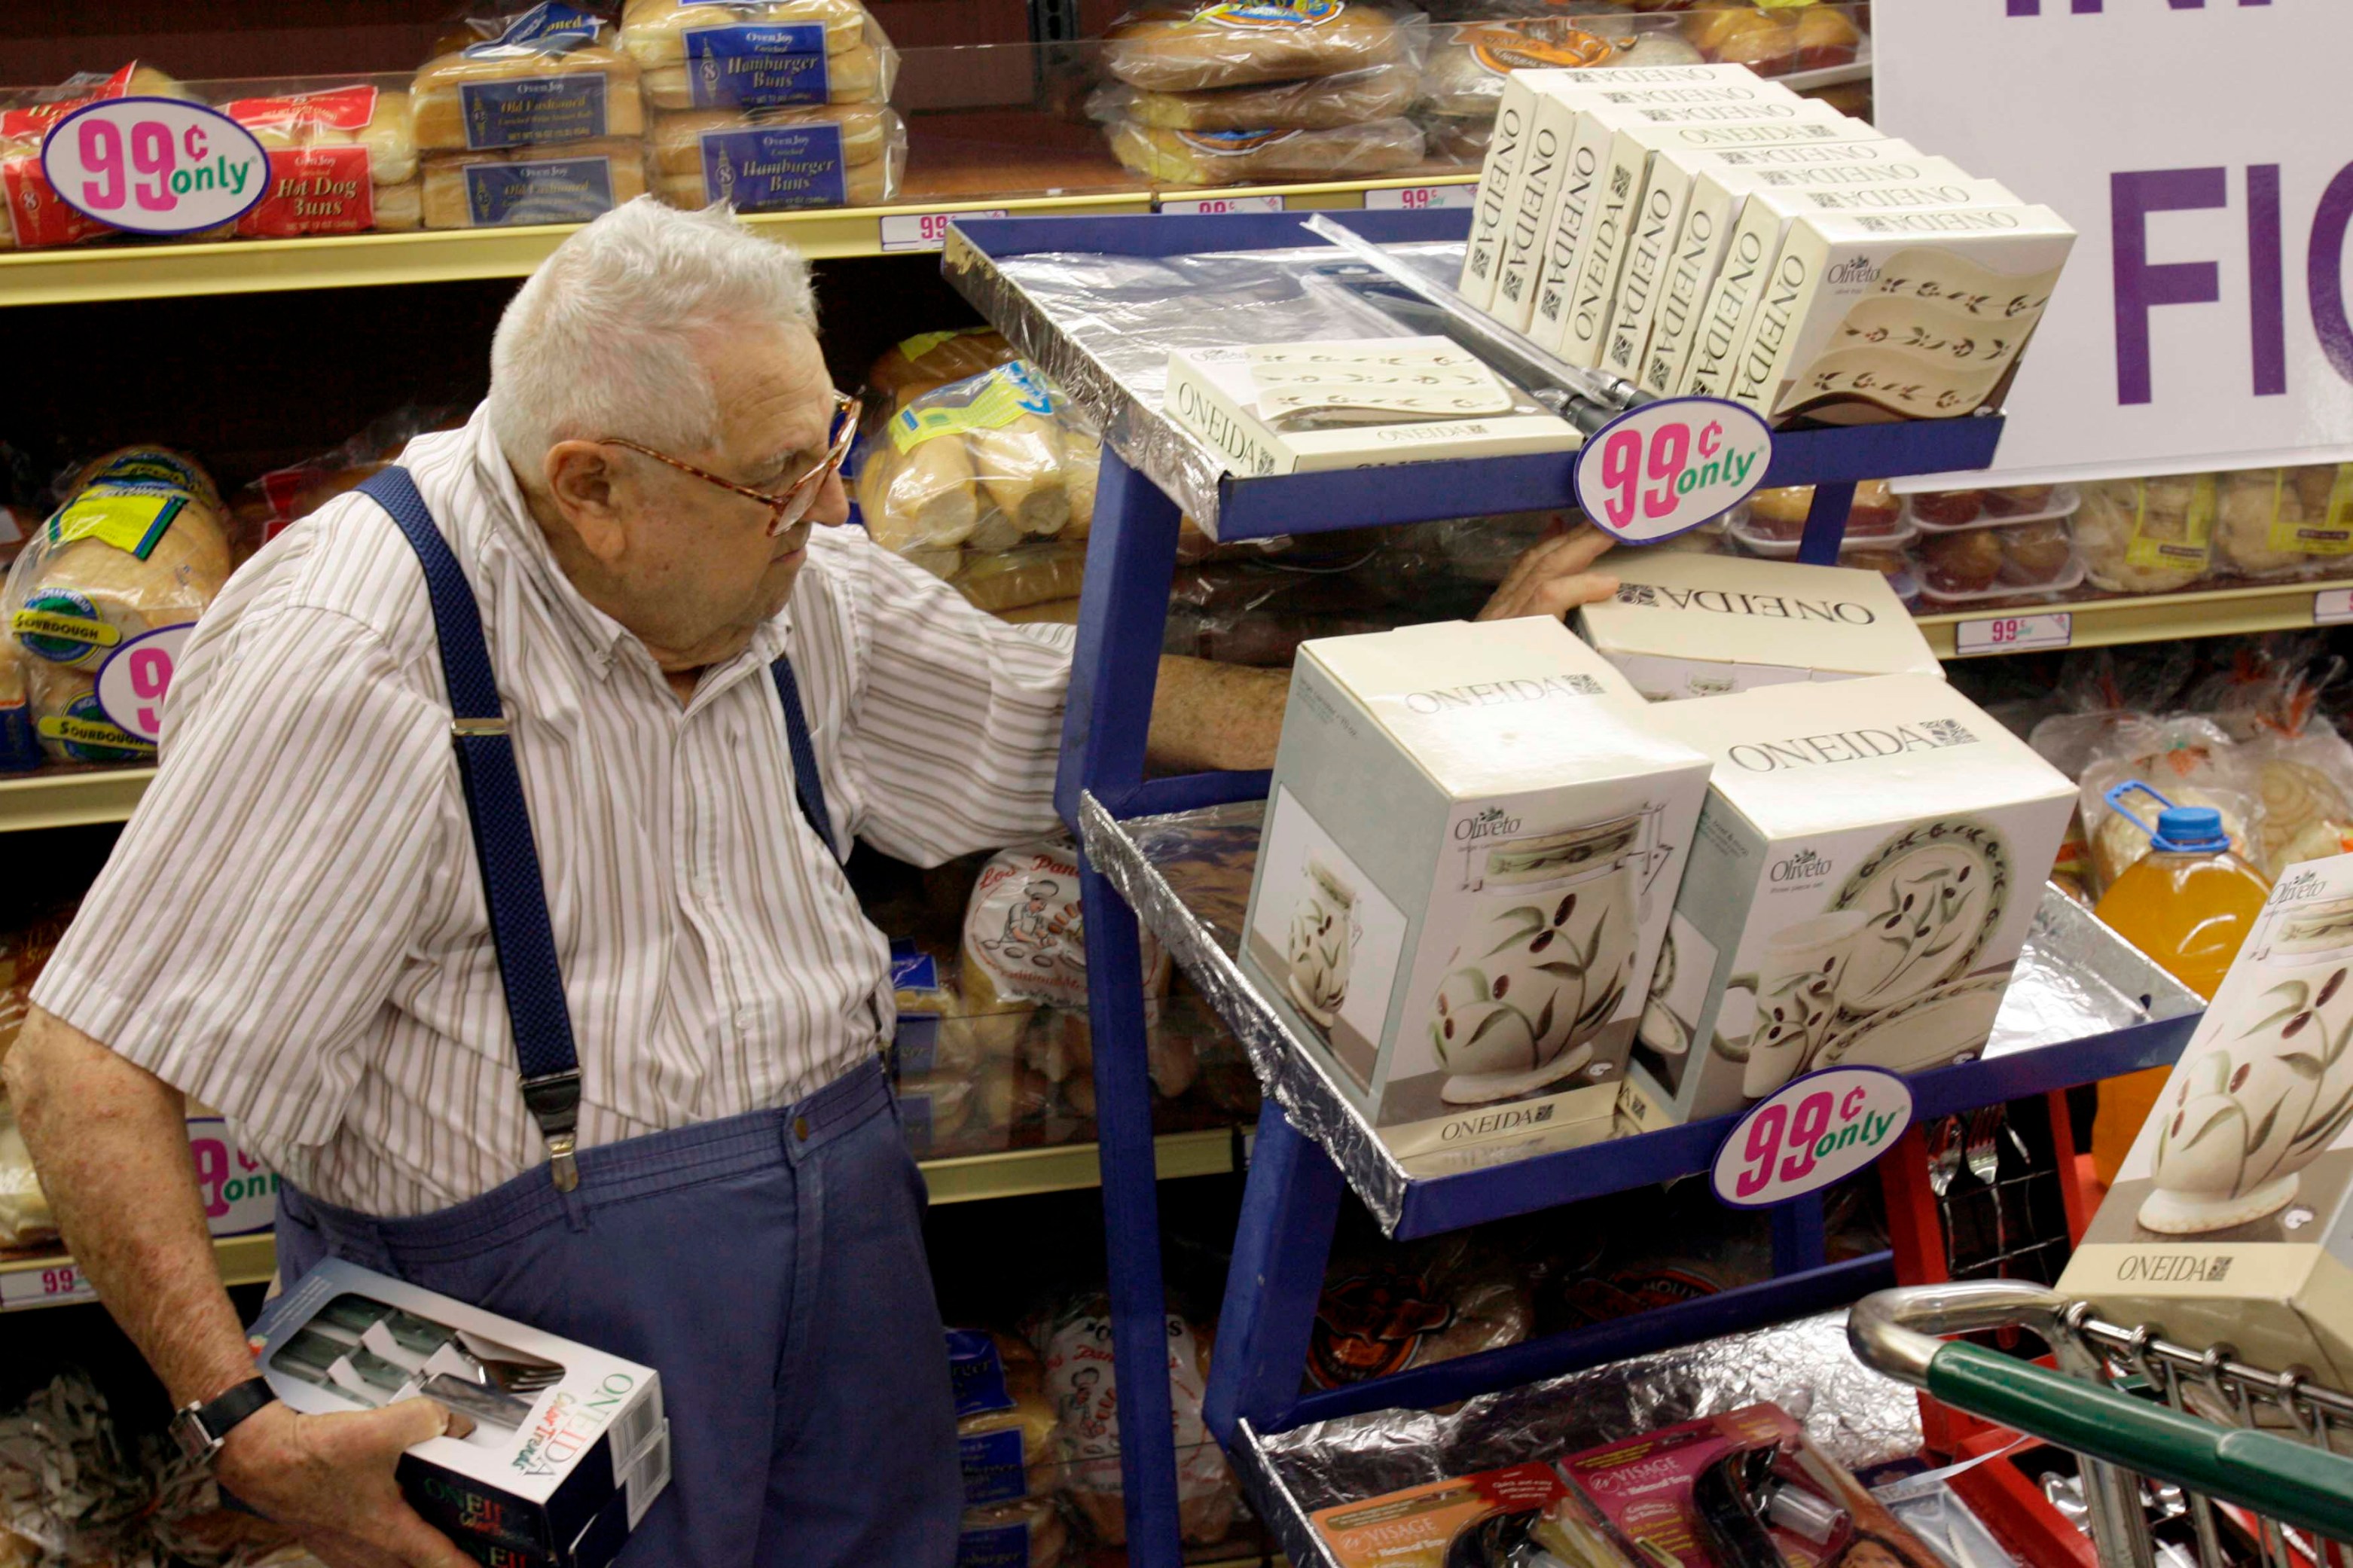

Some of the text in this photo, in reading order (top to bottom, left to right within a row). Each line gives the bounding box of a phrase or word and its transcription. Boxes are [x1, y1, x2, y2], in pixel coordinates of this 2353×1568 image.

[728, 54, 819, 75] Hamburger
[1595, 67, 1716, 83] ONEIDA
[753, 72, 794, 89] Buns
[1633, 86, 1755, 103] ONEIDA
[1674, 103, 1795, 121] ONEIDA
[1678, 124, 1805, 145] ONEIDA
[743, 157, 835, 178] Hamburger
[1753, 145, 1878, 164] ONEIDA
[171, 155, 249, 195] only
[770, 175, 811, 192] Buns
[1477, 108, 1521, 243] ONEIDA
[1789, 163, 1920, 184] ONEIDA
[314, 175, 358, 200] Dog
[1508, 127, 1558, 266] ONEIDA
[1839, 185, 1970, 207] ONEIDA
[1547, 146, 1595, 285] ONEIDA
[1886, 211, 2019, 231] ONEIDA
[1574, 203, 1624, 341] ONEIDA
[1618, 189, 1672, 330] ONEIDA
[1827, 261, 1881, 285] Oliveto
[1656, 210, 1713, 352] ONEIDA
[1697, 231, 1762, 376] ONEIDA
[1737, 255, 1806, 401] ONEIDA
[1179, 381, 1256, 473] ONEIDA
[1378, 425, 1466, 442] ONEIDA
[1677, 447, 1756, 495] only
[1657, 586, 1875, 625] ONEIDA
[1404, 676, 1577, 715] ONEIDA
[1729, 723, 1940, 773] ONEIDA
[1454, 816, 1522, 840] Oliveto
[1030, 853, 1082, 879] Pan
[1769, 856, 1833, 883] Oliveto
[2267, 879, 2327, 906] Oliveto
[1442, 1108, 1534, 1142] ONEIDA
[1815, 1110, 1897, 1158] only
[2116, 1254, 2209, 1282] ONEIDA
[522, 1373, 634, 1476] ONEIDA
[511, 1424, 556, 1470] Trends
[1612, 1456, 1682, 1482] VISAGE
[1364, 1516, 1438, 1542] VISAGE
